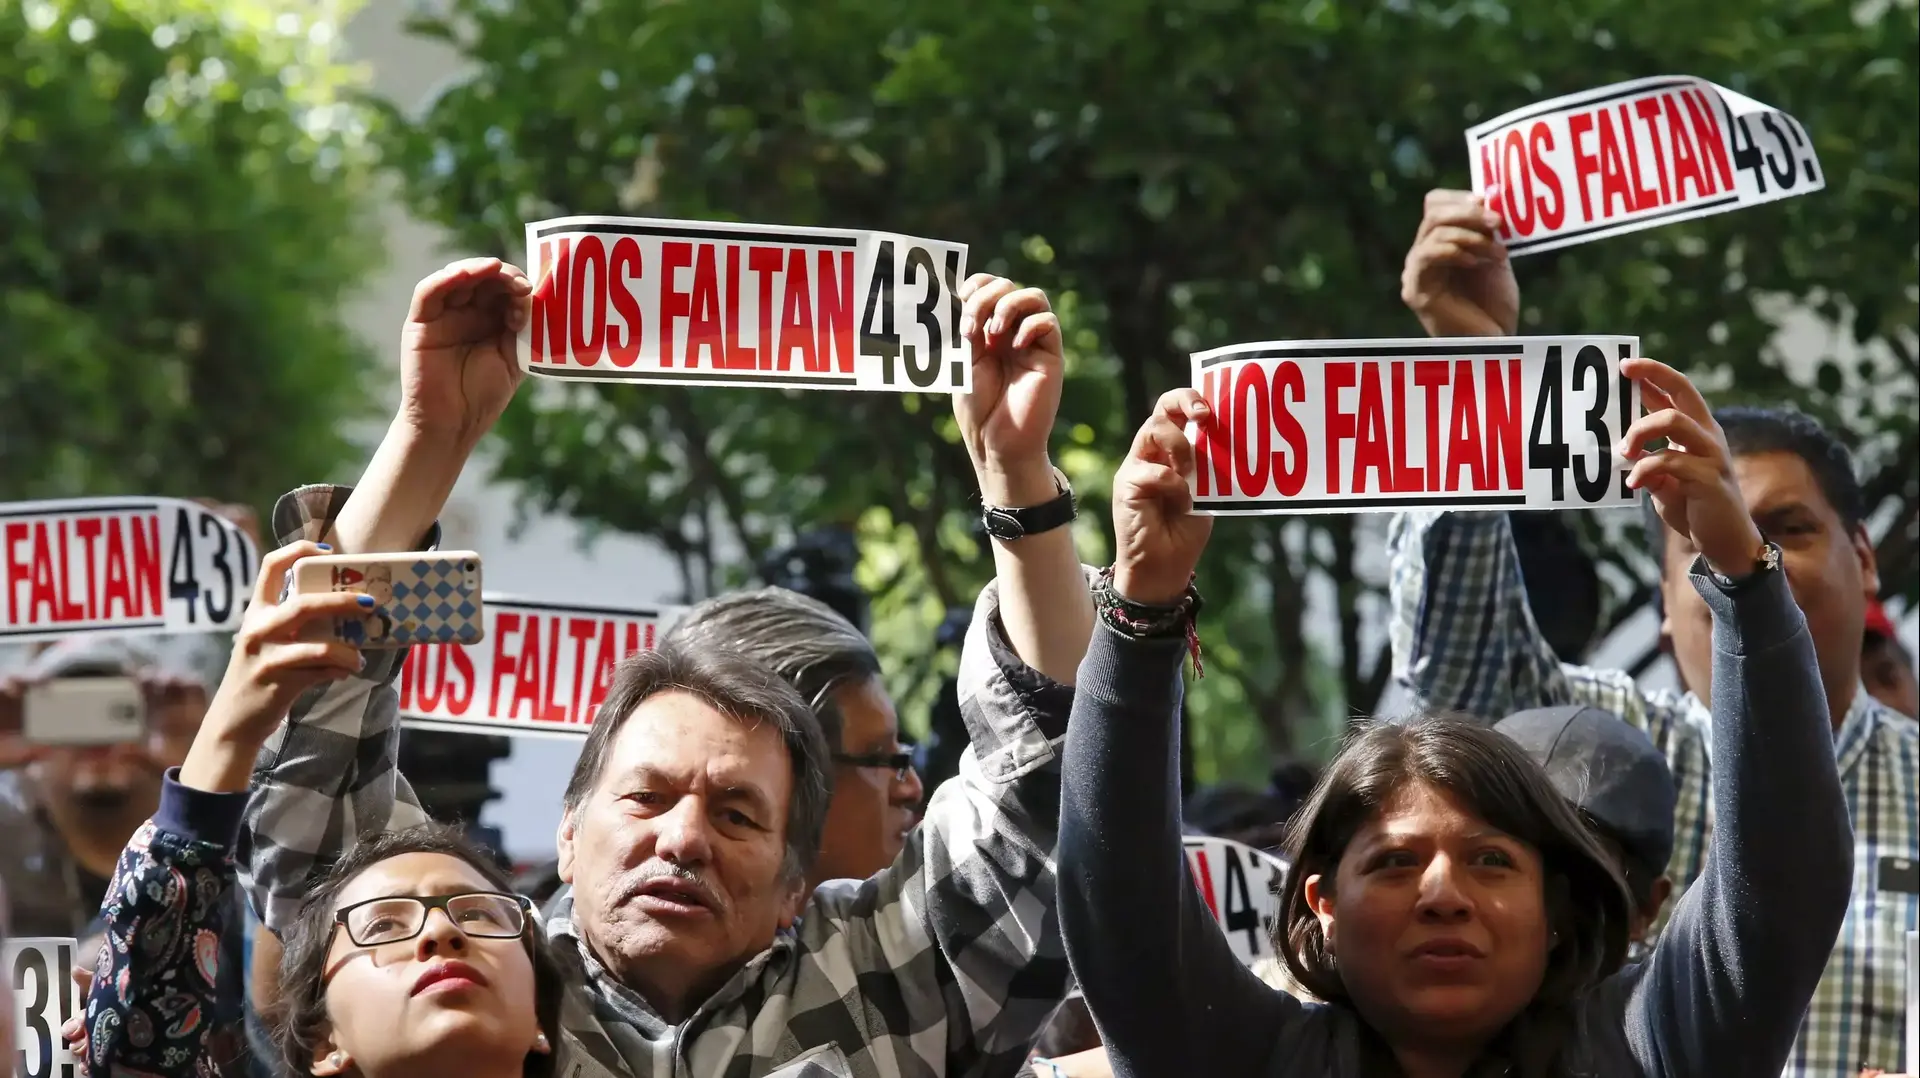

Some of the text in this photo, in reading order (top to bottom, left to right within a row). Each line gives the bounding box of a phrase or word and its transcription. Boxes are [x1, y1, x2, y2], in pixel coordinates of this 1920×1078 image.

[1481, 121, 1566, 239] NOS
[1568, 87, 1735, 222] FALTAN
[530, 235, 964, 388] NOS FALTAN 43!
[1195, 344, 1634, 503] NOS FALTAN 43!
[5, 507, 250, 625] FALTAN 43!
